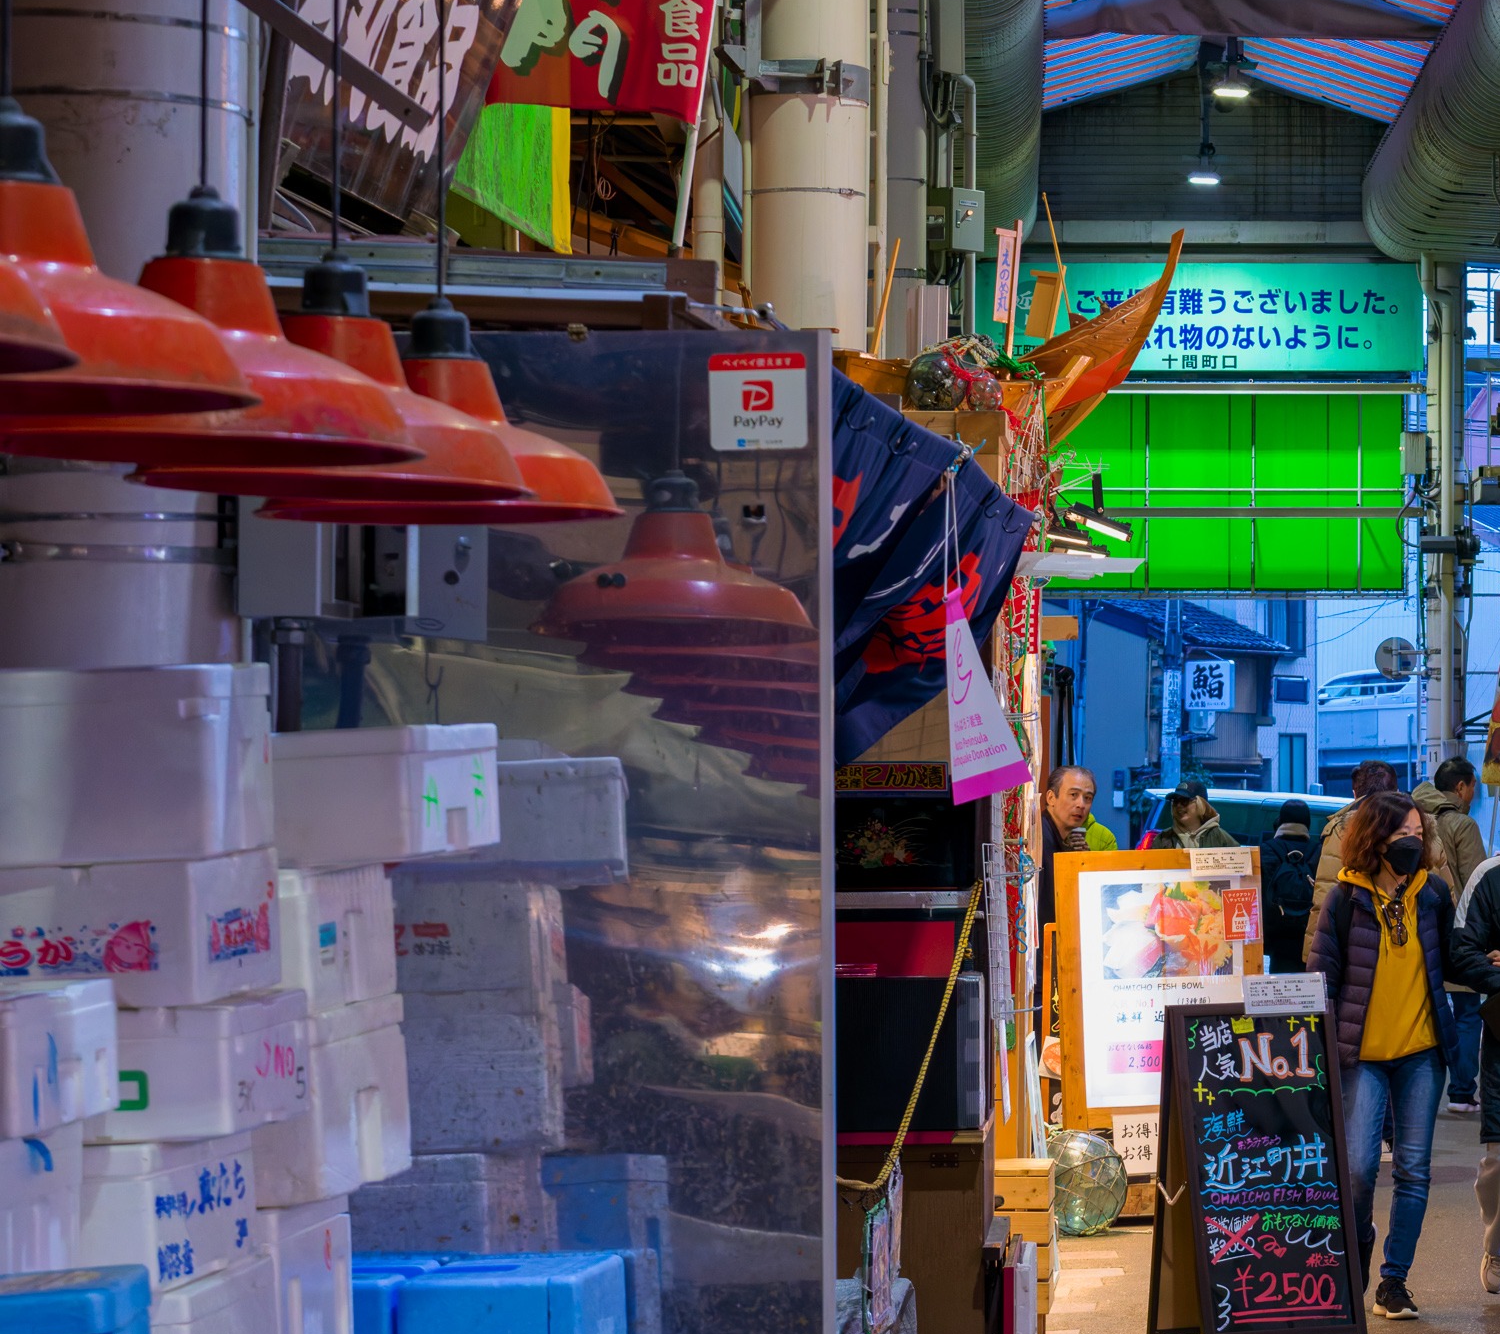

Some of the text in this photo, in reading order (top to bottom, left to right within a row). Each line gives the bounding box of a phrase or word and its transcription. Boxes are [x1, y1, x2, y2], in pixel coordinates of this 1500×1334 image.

[1141, 323, 1373, 351] れ物のないように。
[1162, 354, 1239, 370] 十間町口
[733, 415, 784, 428] PayPay
[1190, 663, 1224, 700] 鮨
[971, 742, 1008, 760] Donation
[1113, 982, 1204, 992] OHMICHO FISH BOWL
[1199, 1020, 1233, 1052] 当店
[1128, 1055, 1160, 1069] 2,500
[1198, 1053, 1240, 1081] 人気
[1202, 1108, 1246, 1138] 海鮮
[1203, 1132, 1328, 1187] 近江町丼
[1211, 1192, 1271, 1205] OHMICHO
[1273, 1188, 1301, 1203] FISH
[1261, 1212, 1342, 1231] おもてなし価格
[1305, 1252, 1340, 1267] 税込
